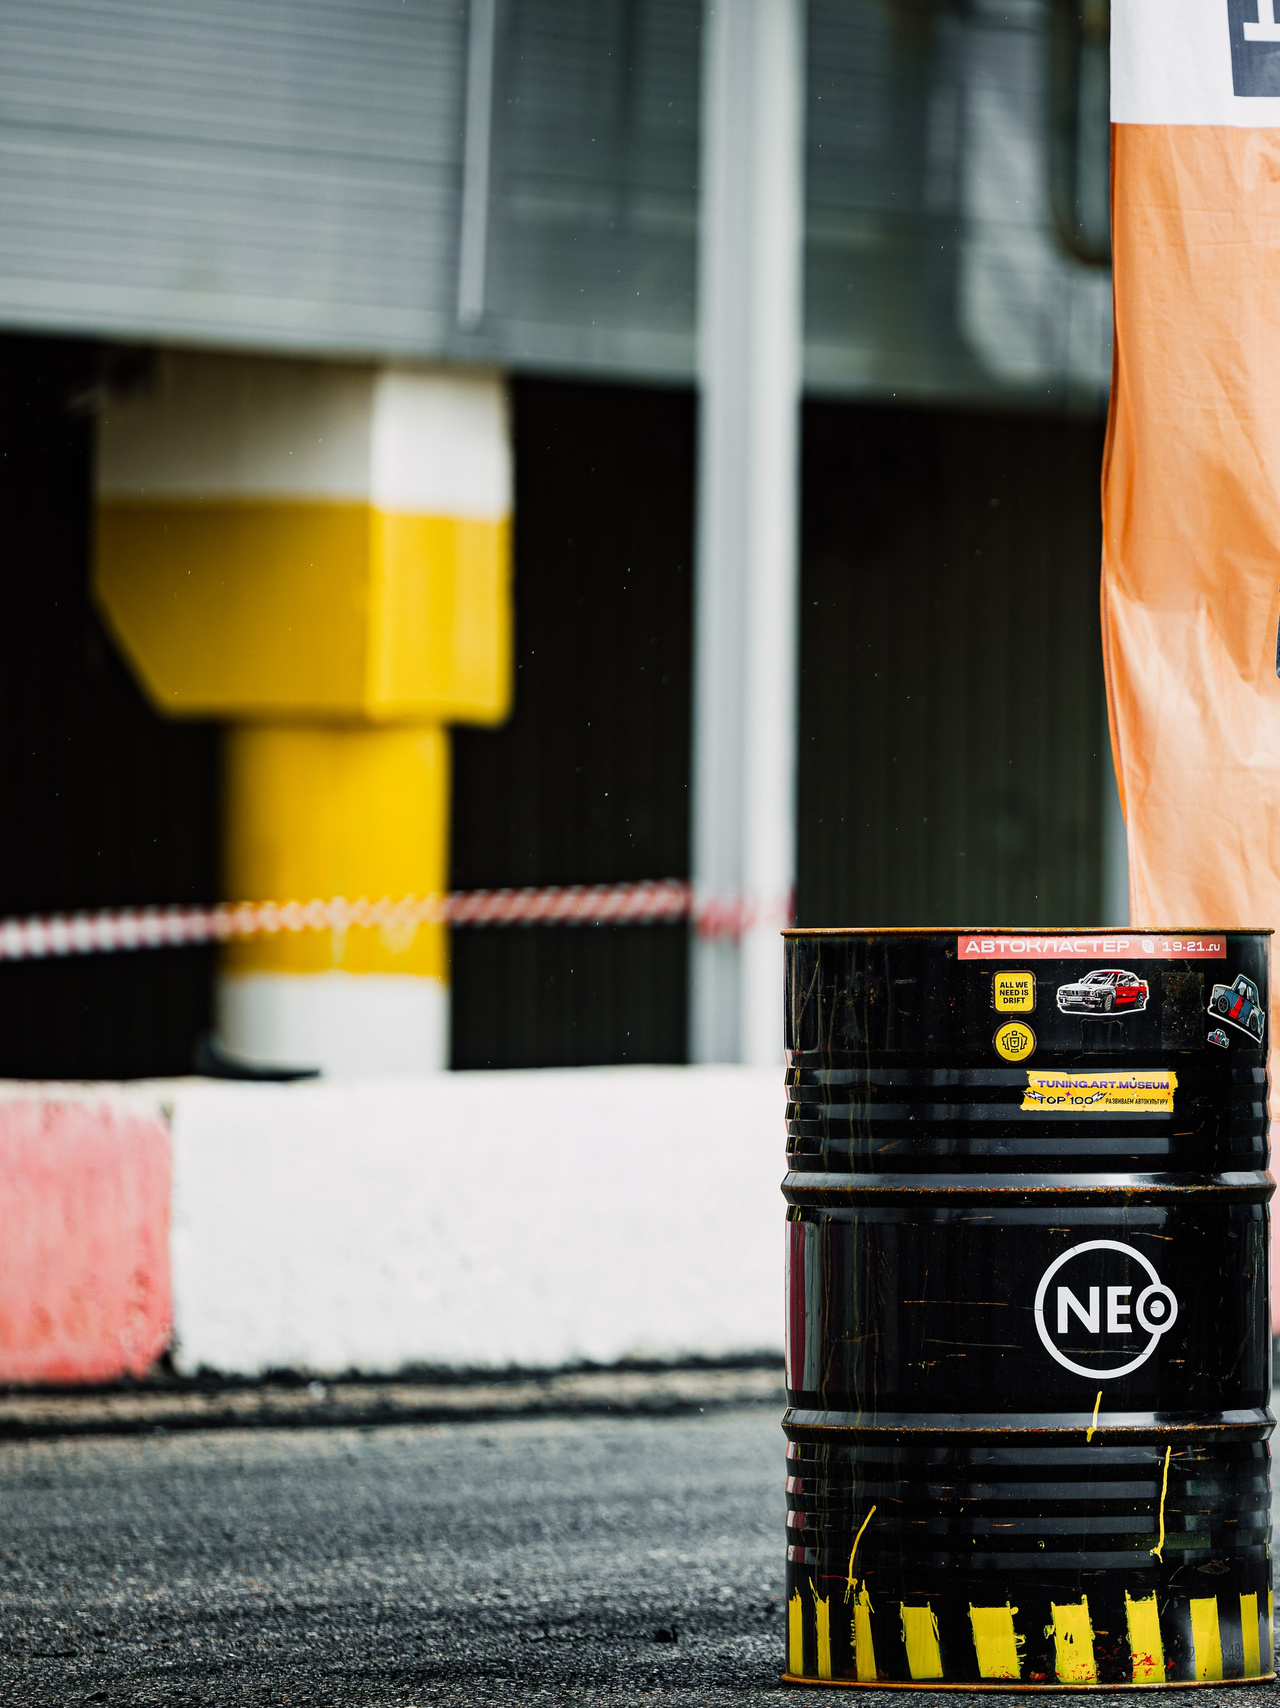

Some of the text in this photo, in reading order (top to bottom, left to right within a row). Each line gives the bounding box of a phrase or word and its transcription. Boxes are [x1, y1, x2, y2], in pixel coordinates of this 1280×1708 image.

[964, 940, 1221, 954] АВТОКЛАСТЕР 19-21.ru
[1037, 1080, 1169, 1089] TUNING.ART.MUSEUM
[1039, 1096, 1095, 1105] TOP 100
[1057, 1283, 1178, 1334] NEO
